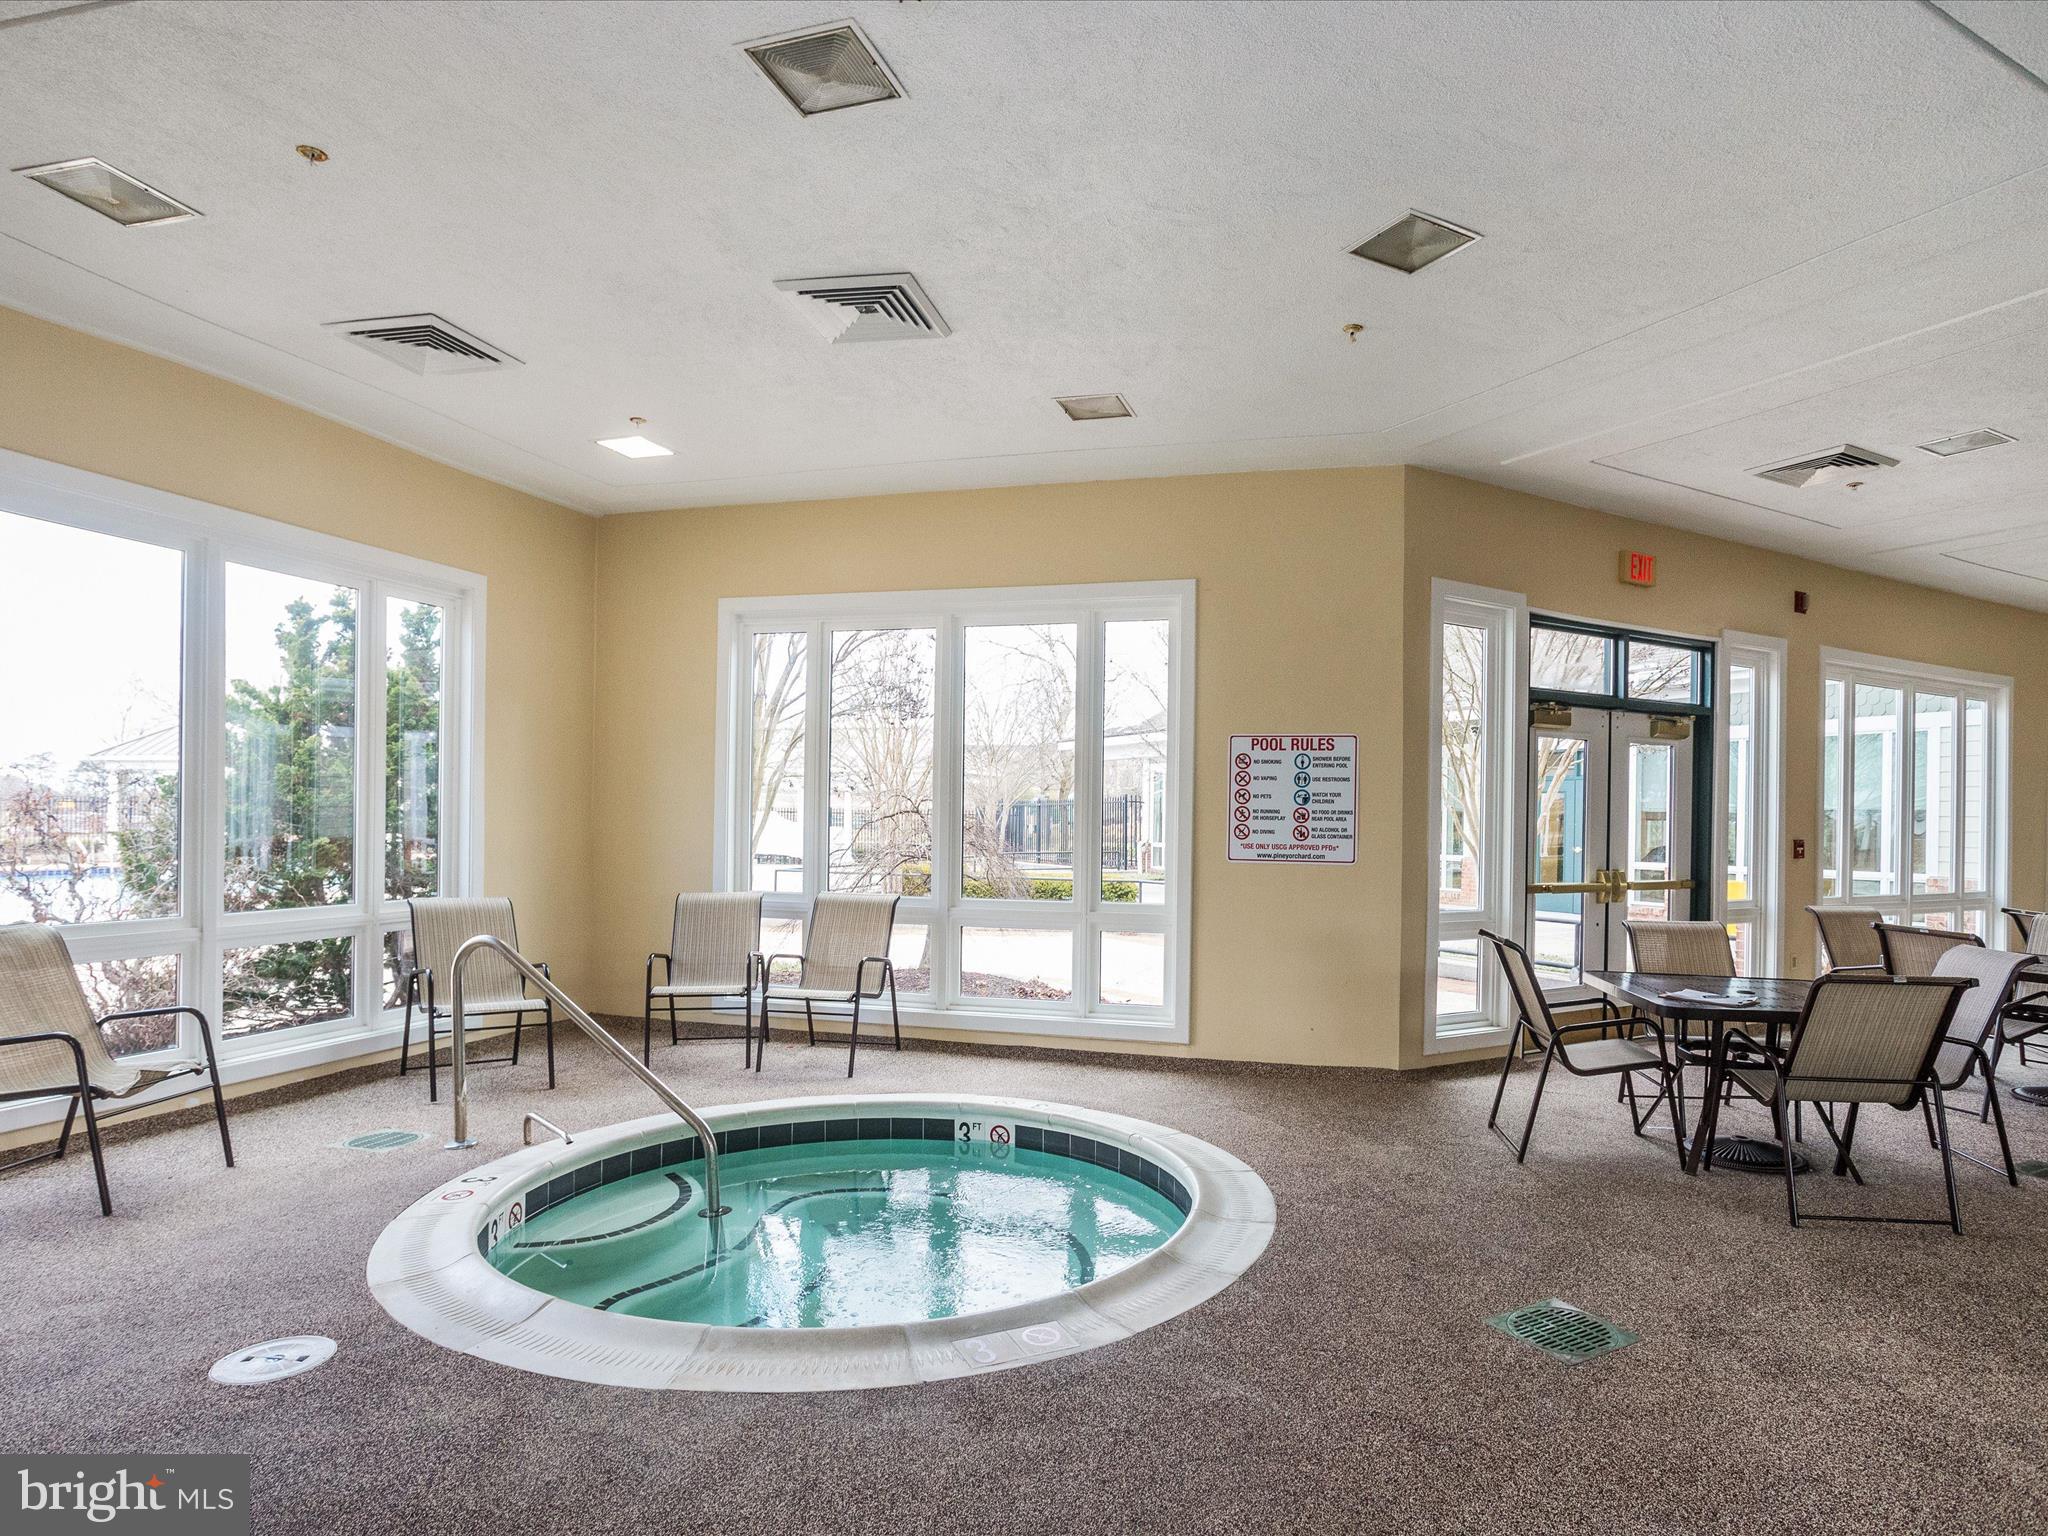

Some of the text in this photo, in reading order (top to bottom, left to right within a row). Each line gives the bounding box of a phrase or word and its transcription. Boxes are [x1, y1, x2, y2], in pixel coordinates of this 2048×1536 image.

[1631, 552, 1655, 584] EXIT
[1251, 738, 1335, 751] POOL RULES
[1271, 843, 1287, 851] USCG
[1256, 852, 1326, 860] www.pineyorchard.com
[959, 1122, 971, 1142] 3
[491, 1218, 498, 1249] 3
